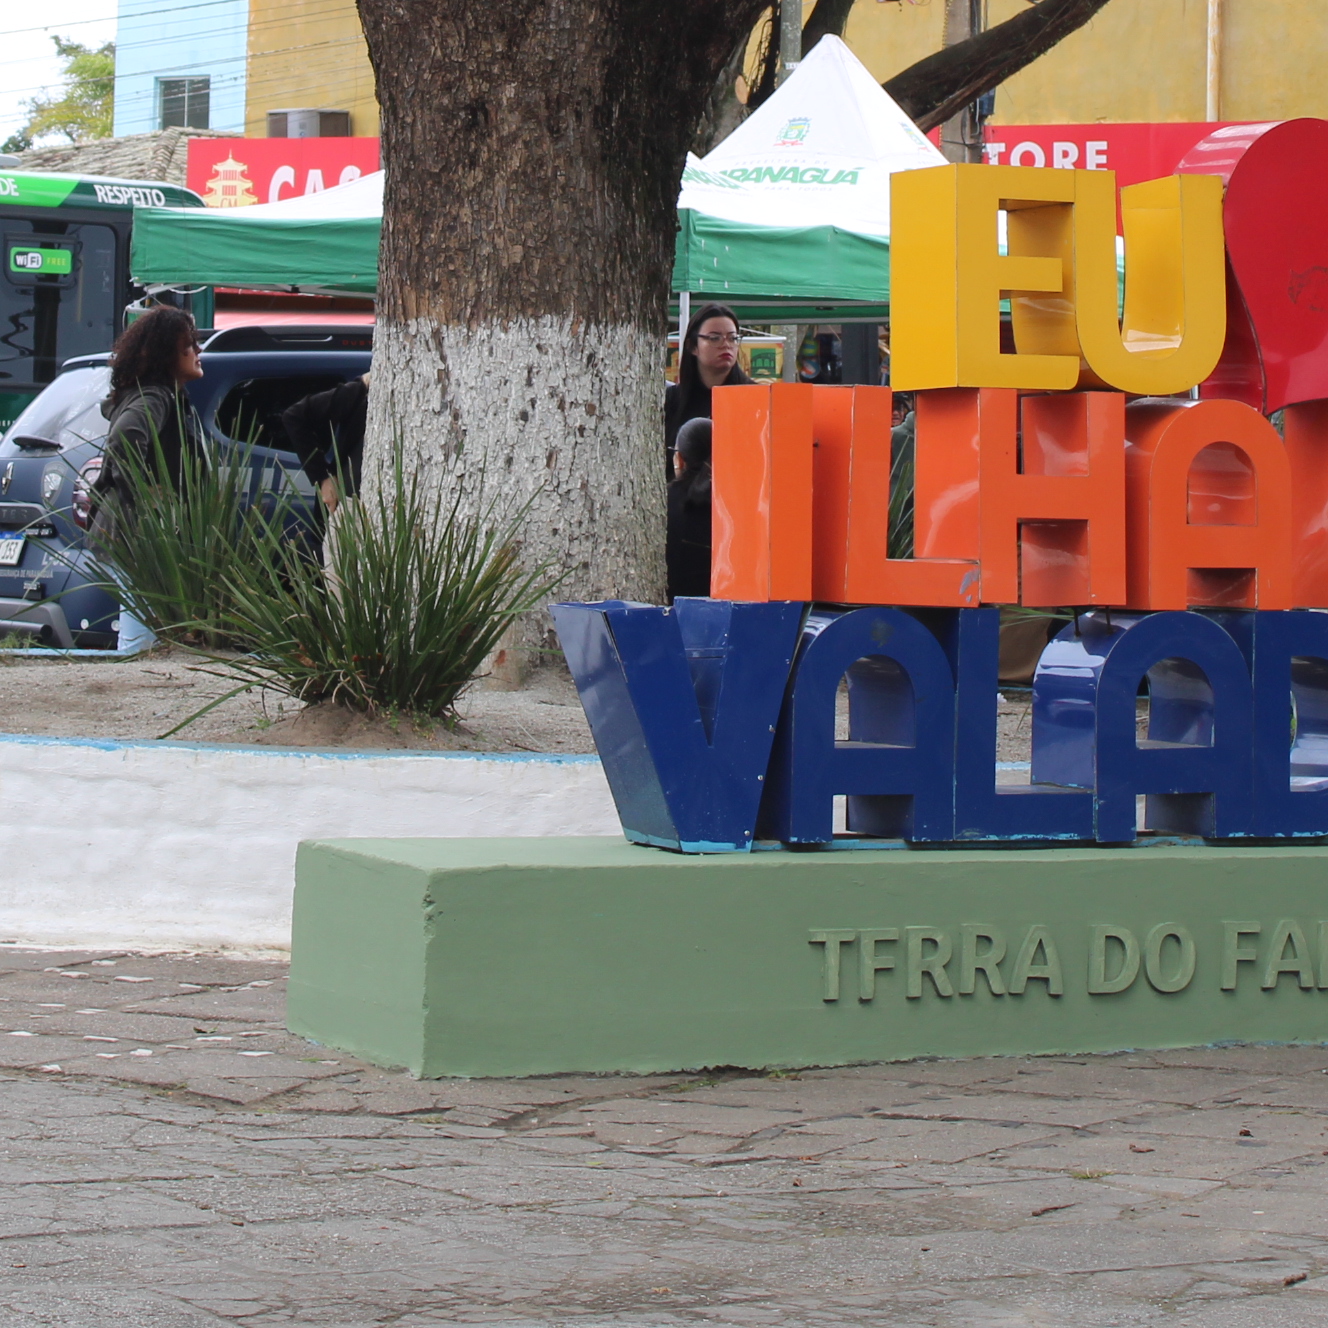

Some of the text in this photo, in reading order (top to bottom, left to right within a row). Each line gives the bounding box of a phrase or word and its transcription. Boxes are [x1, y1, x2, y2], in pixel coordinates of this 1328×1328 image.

[981, 140, 1109, 171] TORE
[93, 184, 166, 207] RESPEITO
[891, 162, 1227, 395] EU
[1087, 920, 1197, 997] DO
